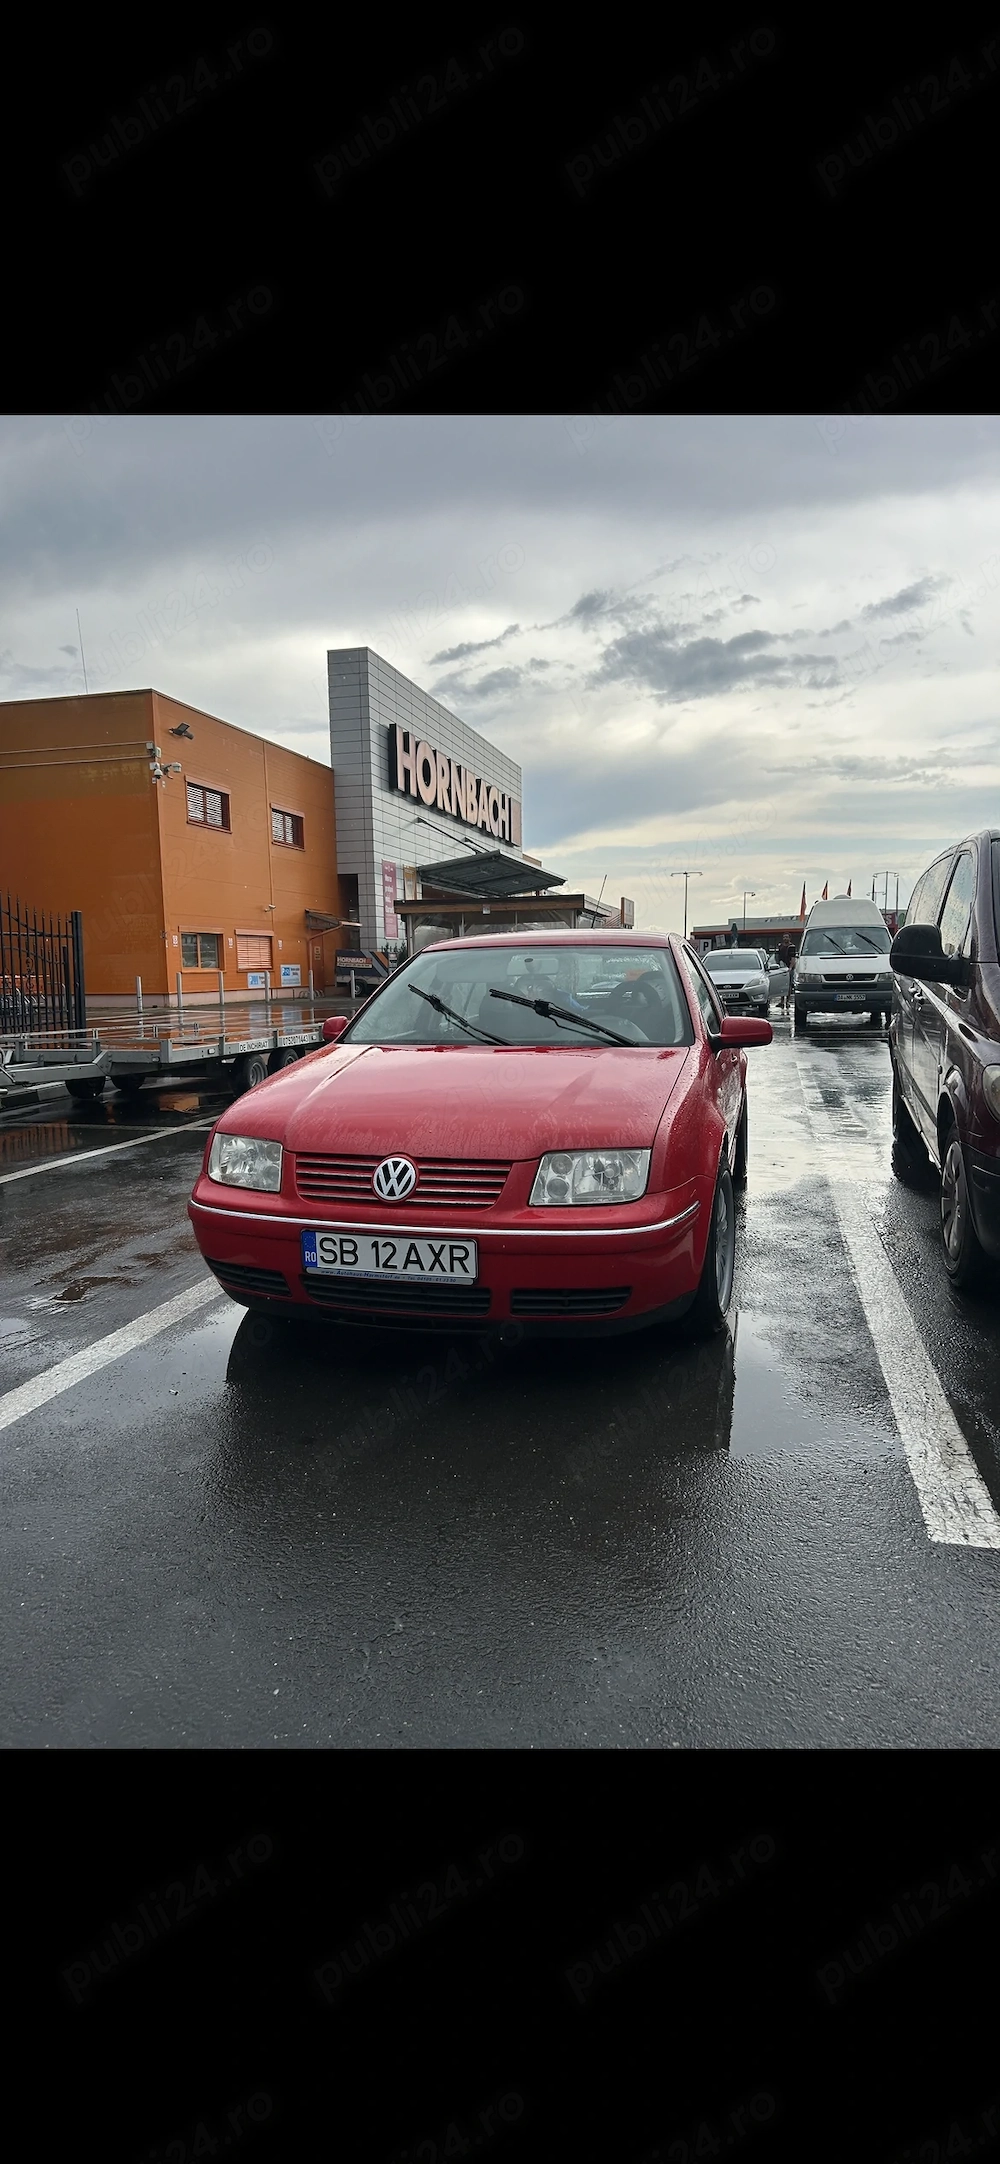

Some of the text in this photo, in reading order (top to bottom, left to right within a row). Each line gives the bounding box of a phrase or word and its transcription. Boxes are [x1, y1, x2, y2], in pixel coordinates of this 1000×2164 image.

[397, 726, 510, 841] HORNBACH
[703, 942, 709, 951] P
[305, 1251, 316, 1263] RO
[319, 1237, 470, 1273] SB 12 AXR
